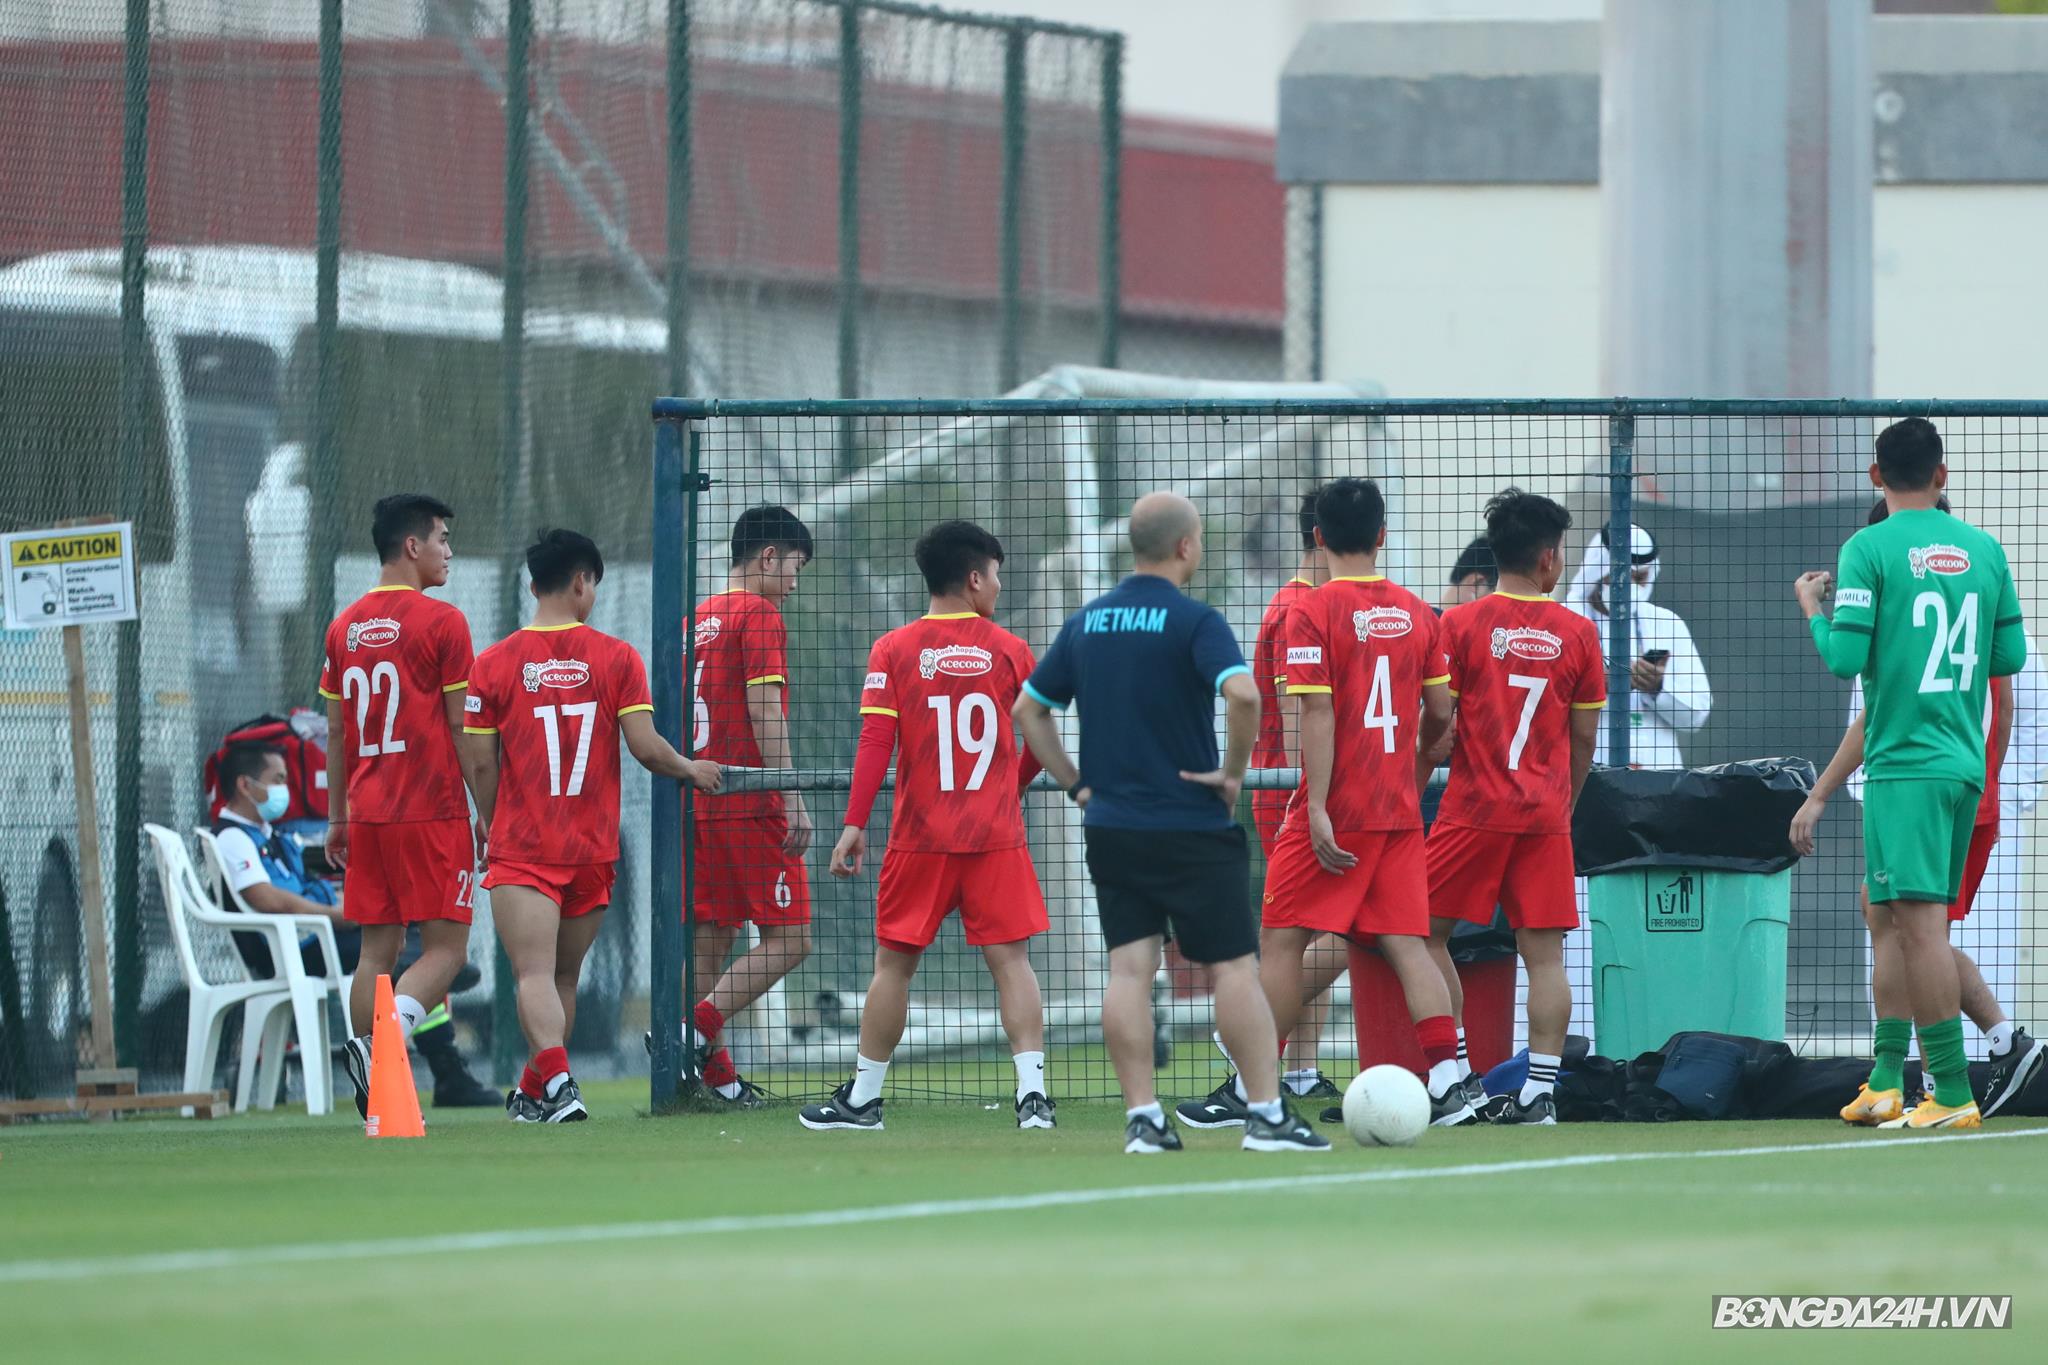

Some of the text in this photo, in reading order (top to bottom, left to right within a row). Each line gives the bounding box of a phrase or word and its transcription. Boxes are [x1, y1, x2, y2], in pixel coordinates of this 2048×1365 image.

[37, 537, 117, 560] CAUTION
[65, 563, 120, 575] Construction
[68, 586, 95, 595] Watch
[82, 593, 114, 602] moving
[1083, 606, 1168, 634] VIETNAM
[1288, 650, 1320, 660] AMILK
[1912, 591, 1978, 694] 24
[342, 661, 406, 757] 22
[1363, 655, 1399, 754] 4
[1508, 673, 1549, 771] 7
[533, 701, 598, 797] 17
[927, 692, 998, 792] 19
[775, 871, 792, 908] 6
[1664, 918, 1700, 928] PROHIBITED
